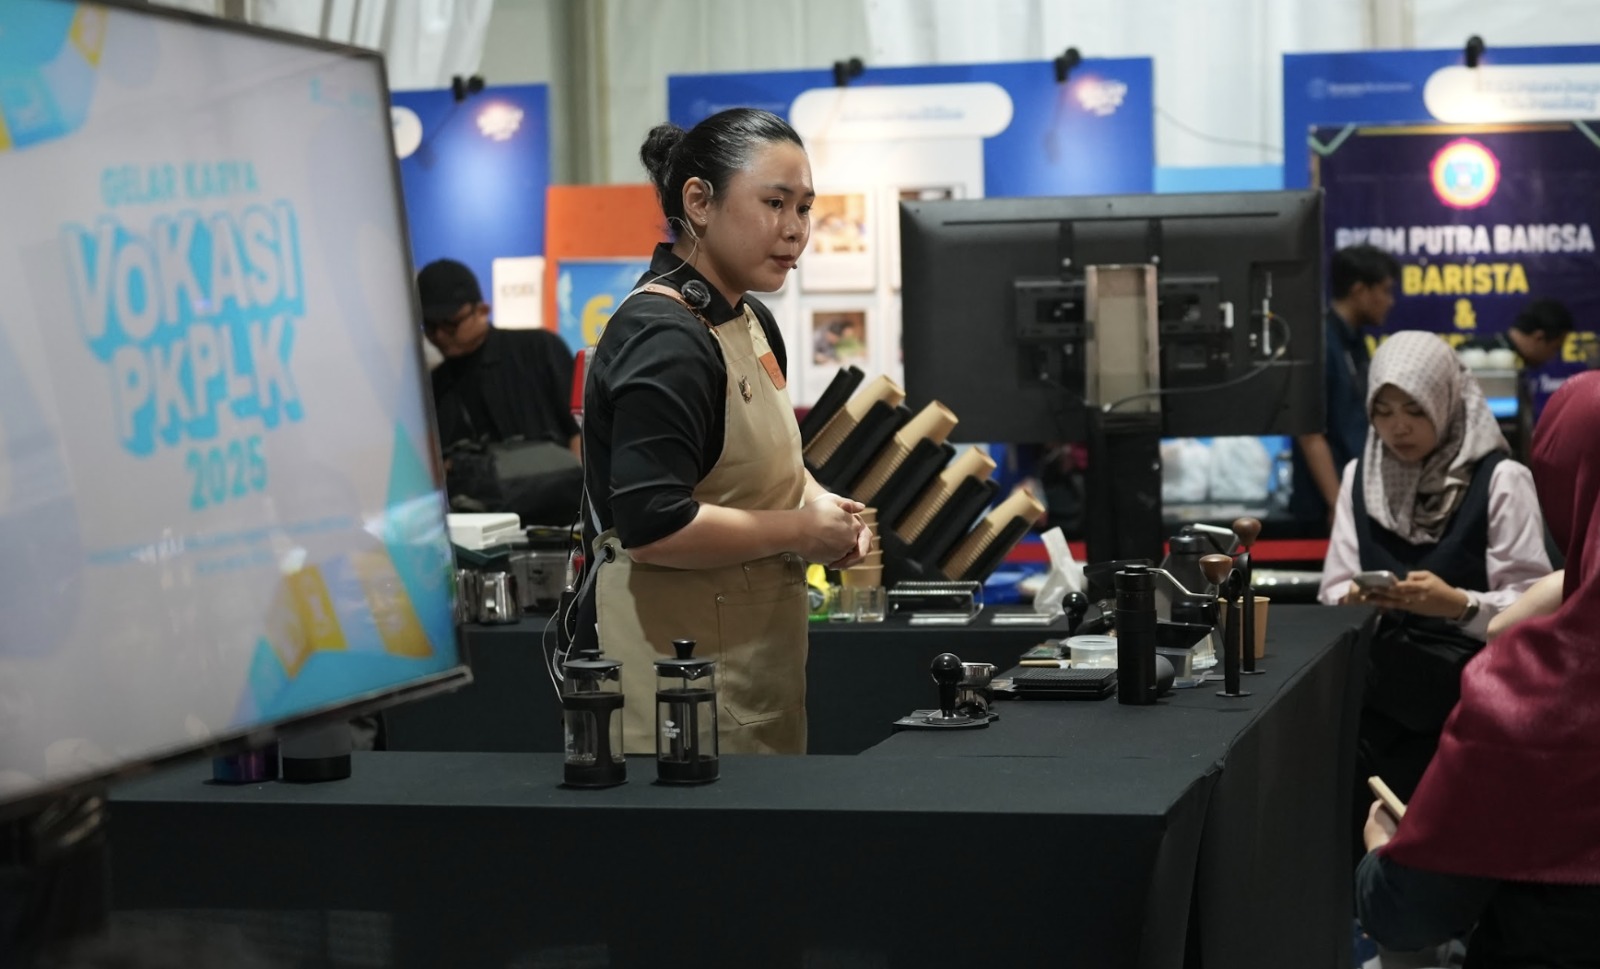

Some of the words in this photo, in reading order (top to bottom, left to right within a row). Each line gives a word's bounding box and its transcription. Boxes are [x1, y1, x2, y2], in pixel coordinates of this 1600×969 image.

[1409, 225, 1490, 254] PUTRA
[1494, 223, 1594, 252] BANGSA
[61, 200, 305, 358] VOKASI
[1402, 263, 1529, 295] BARISTA
[1454, 298, 1476, 329] &
[112, 318, 303, 456] PKPLK
[187, 434, 267, 509] 2025
